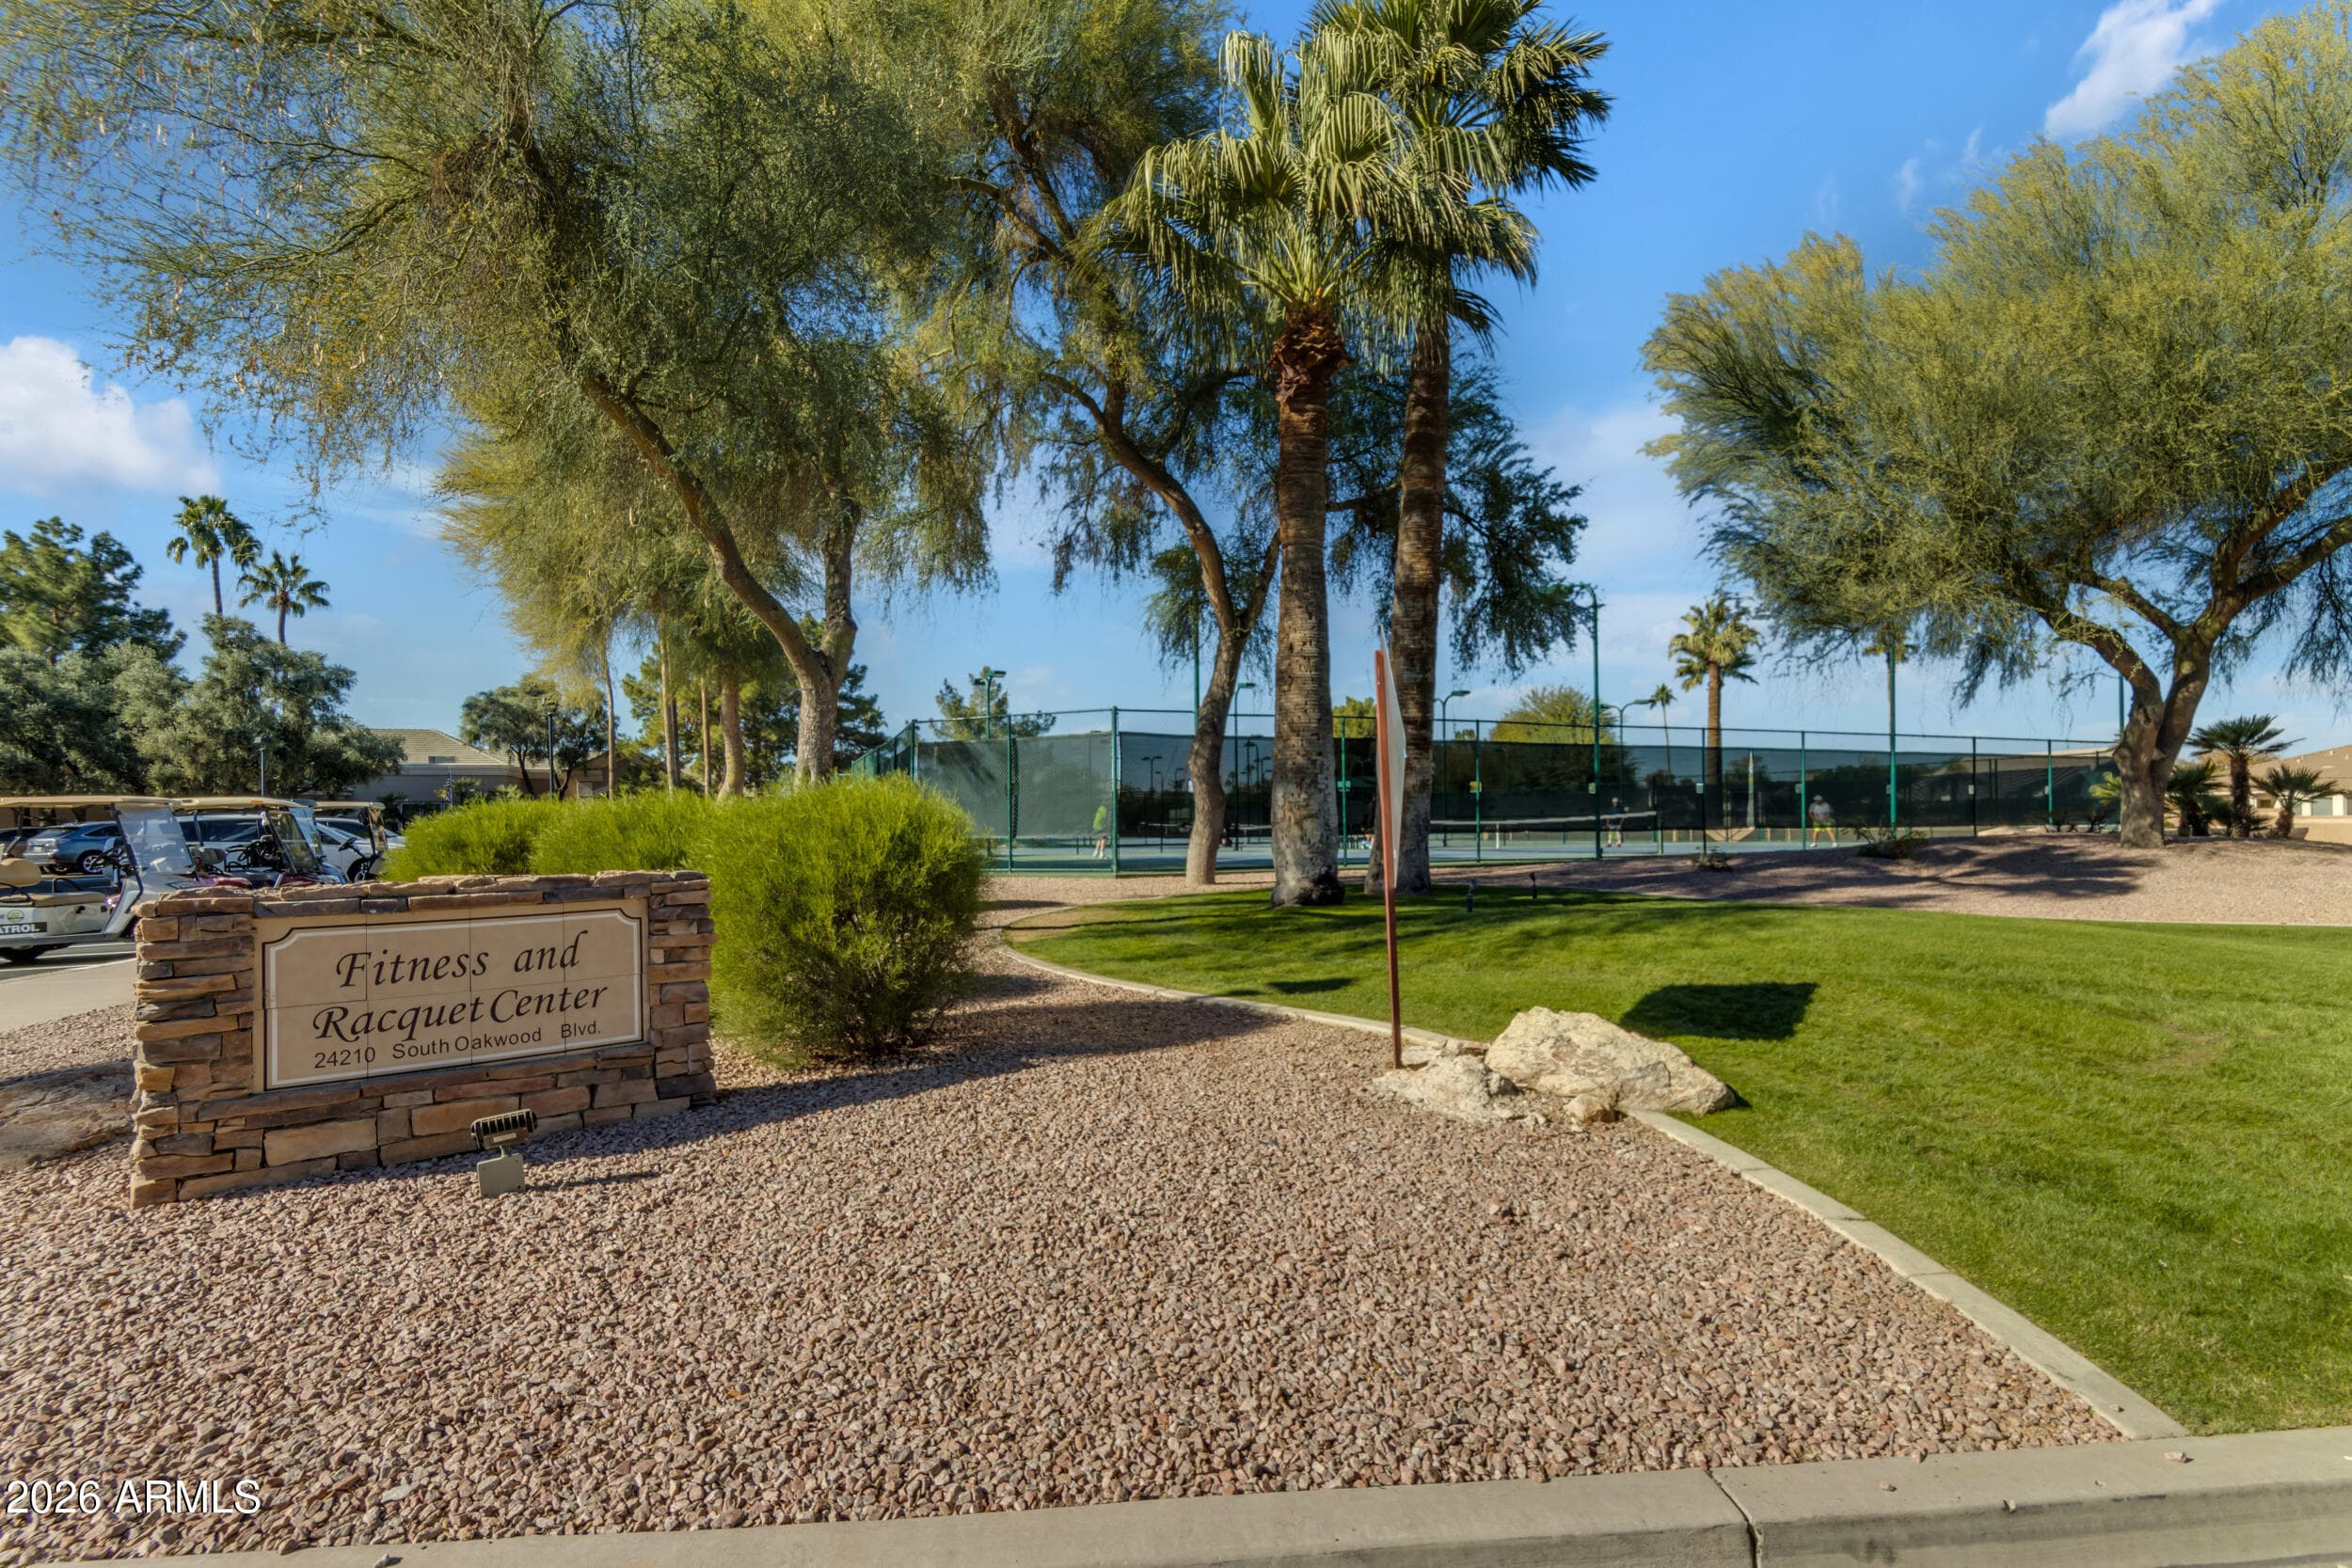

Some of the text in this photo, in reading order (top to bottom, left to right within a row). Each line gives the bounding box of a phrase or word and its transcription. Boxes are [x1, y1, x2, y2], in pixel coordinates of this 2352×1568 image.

[336, 930, 588, 988] Fitness and
[312, 986, 608, 1043] Racquet Center
[314, 1021, 601, 1069] 24210 South Oakwood Blvd.
